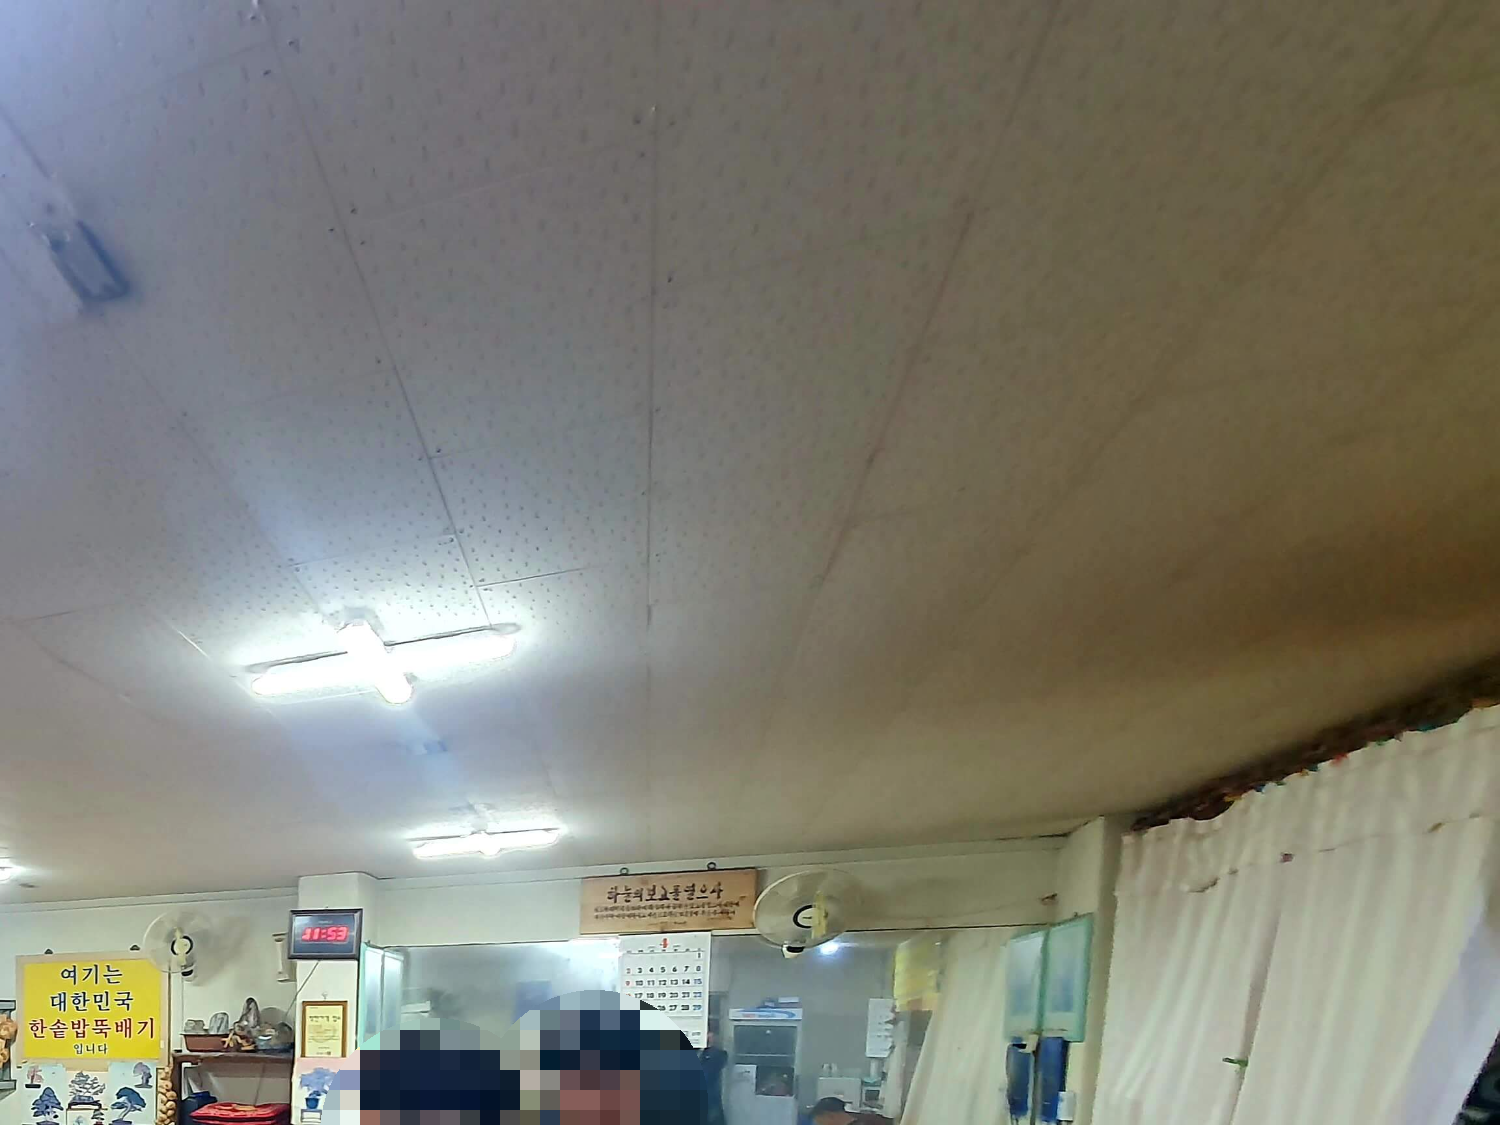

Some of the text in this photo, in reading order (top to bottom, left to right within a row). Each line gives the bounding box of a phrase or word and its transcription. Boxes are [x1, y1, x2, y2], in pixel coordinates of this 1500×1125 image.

[302, 927, 348, 942] 11:53
[61, 964, 122, 985] 여기는
[50, 991, 134, 1012] 대한민국
[29, 1018, 154, 1039] 한솥밥뚝배기
[73, 1043, 108, 1054] 입니다
